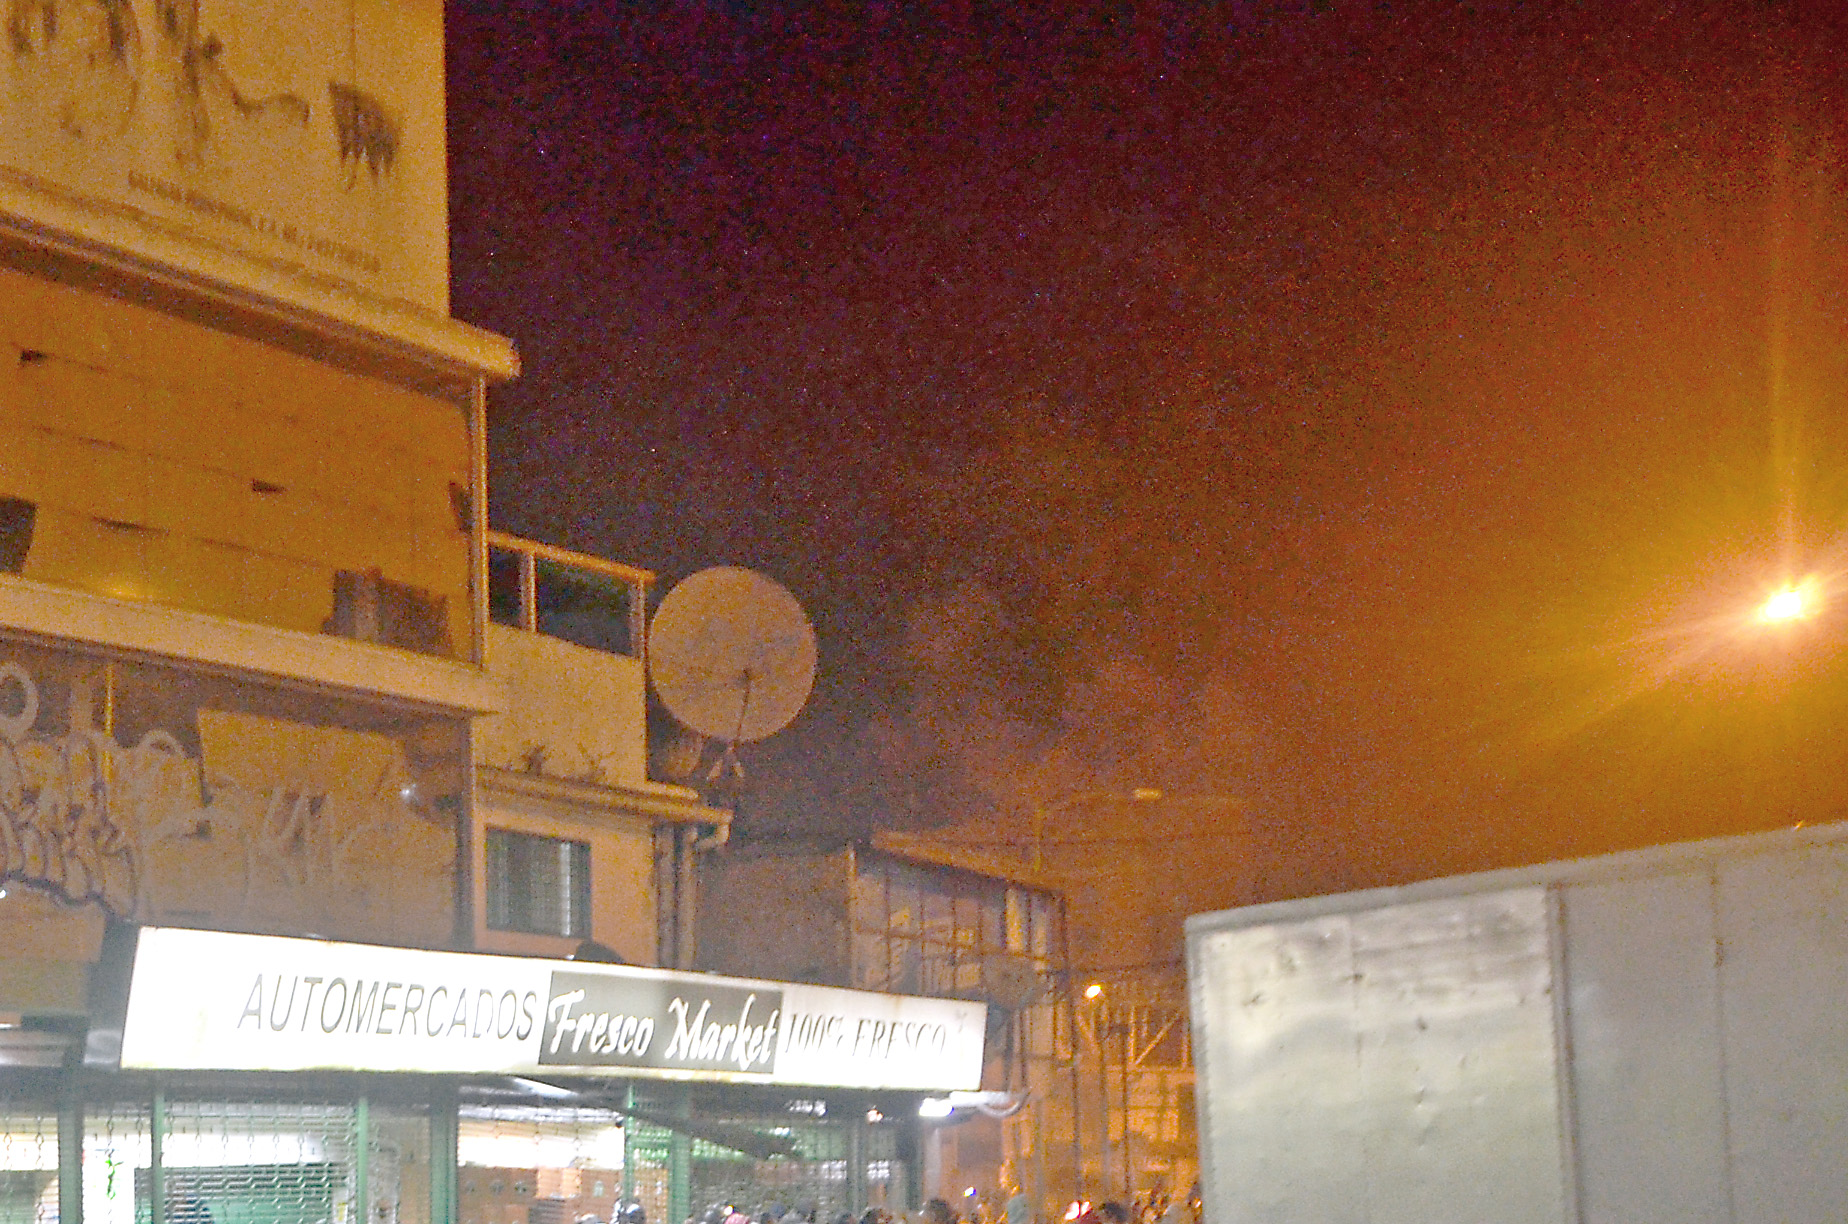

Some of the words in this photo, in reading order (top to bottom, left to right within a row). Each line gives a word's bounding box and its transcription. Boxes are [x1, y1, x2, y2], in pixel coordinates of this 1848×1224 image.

[236, 972, 538, 1041] AUTOMERCADOS
[548, 988, 655, 1057] Fresco
[664, 993, 780, 1071] Market
[852, 1018, 948, 1060] FRESCO
